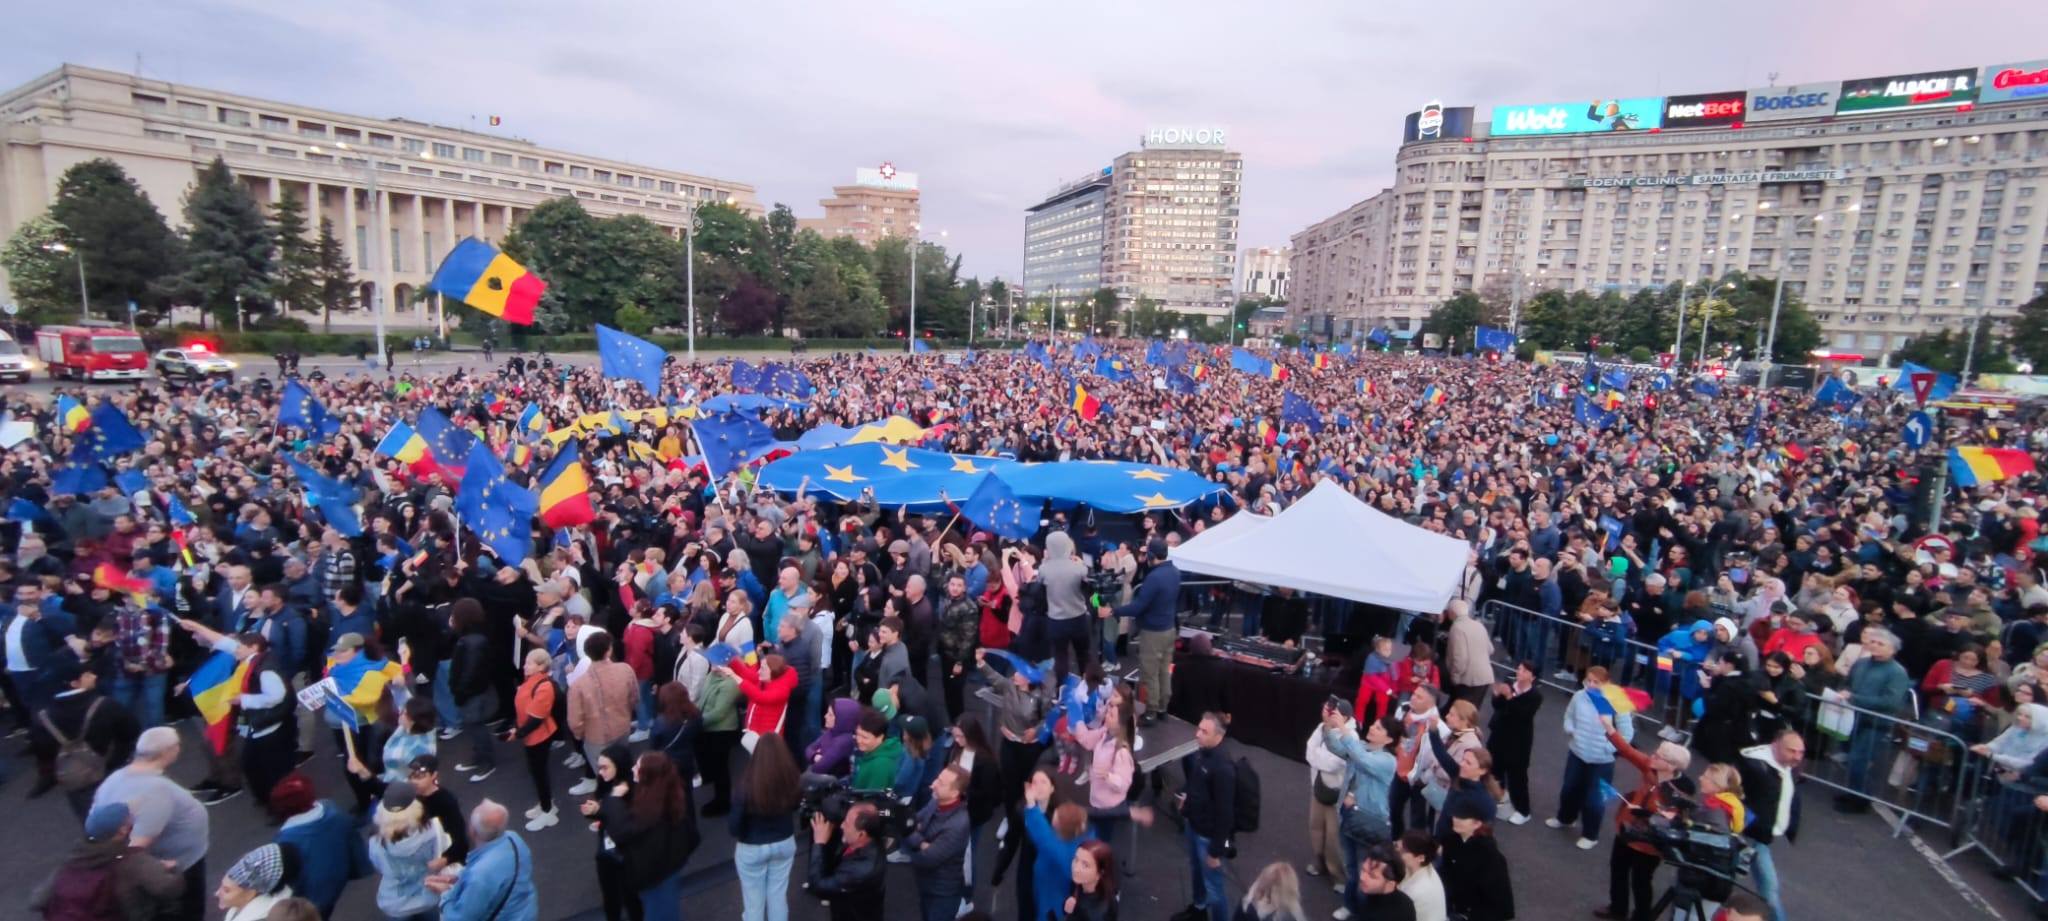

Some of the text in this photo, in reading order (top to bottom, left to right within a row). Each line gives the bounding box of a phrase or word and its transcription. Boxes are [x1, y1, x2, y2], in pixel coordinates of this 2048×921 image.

[1668, 100, 1743, 118] NetBet
[1753, 92, 1829, 111] BORSEC
[1506, 108, 1568, 131] Wolt
[1150, 127, 1225, 145] HONOR
[1583, 177, 1632, 187] EDENT
[1636, 175, 1687, 186] CLINIC
